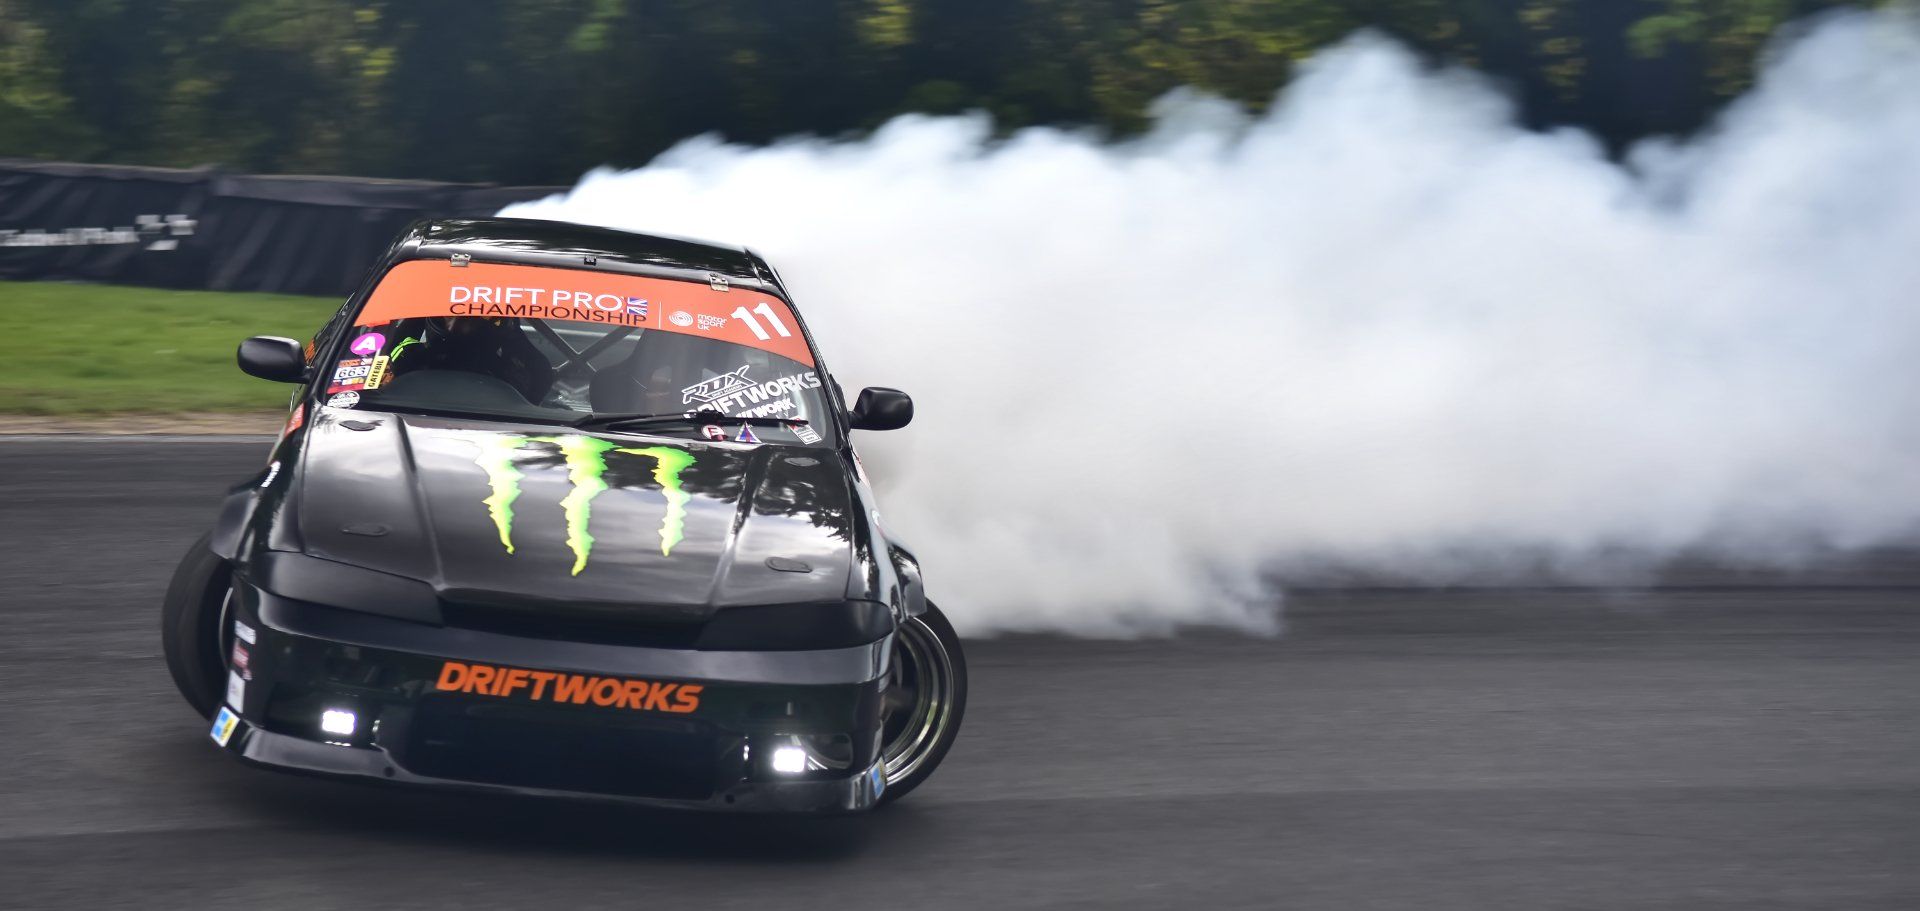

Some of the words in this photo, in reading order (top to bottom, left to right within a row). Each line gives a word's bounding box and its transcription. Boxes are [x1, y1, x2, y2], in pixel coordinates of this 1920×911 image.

[450, 286, 545, 305] DRIFT
[552, 290, 622, 311] PRO
[450, 303, 647, 323] CHAMPIONSHIP
[730, 302, 792, 340] 11
[353, 335, 377, 351] A
[338, 367, 366, 378] 663
[368, 359, 385, 387] GATEBIL
[436, 661, 704, 713] DRIFTWORKS
